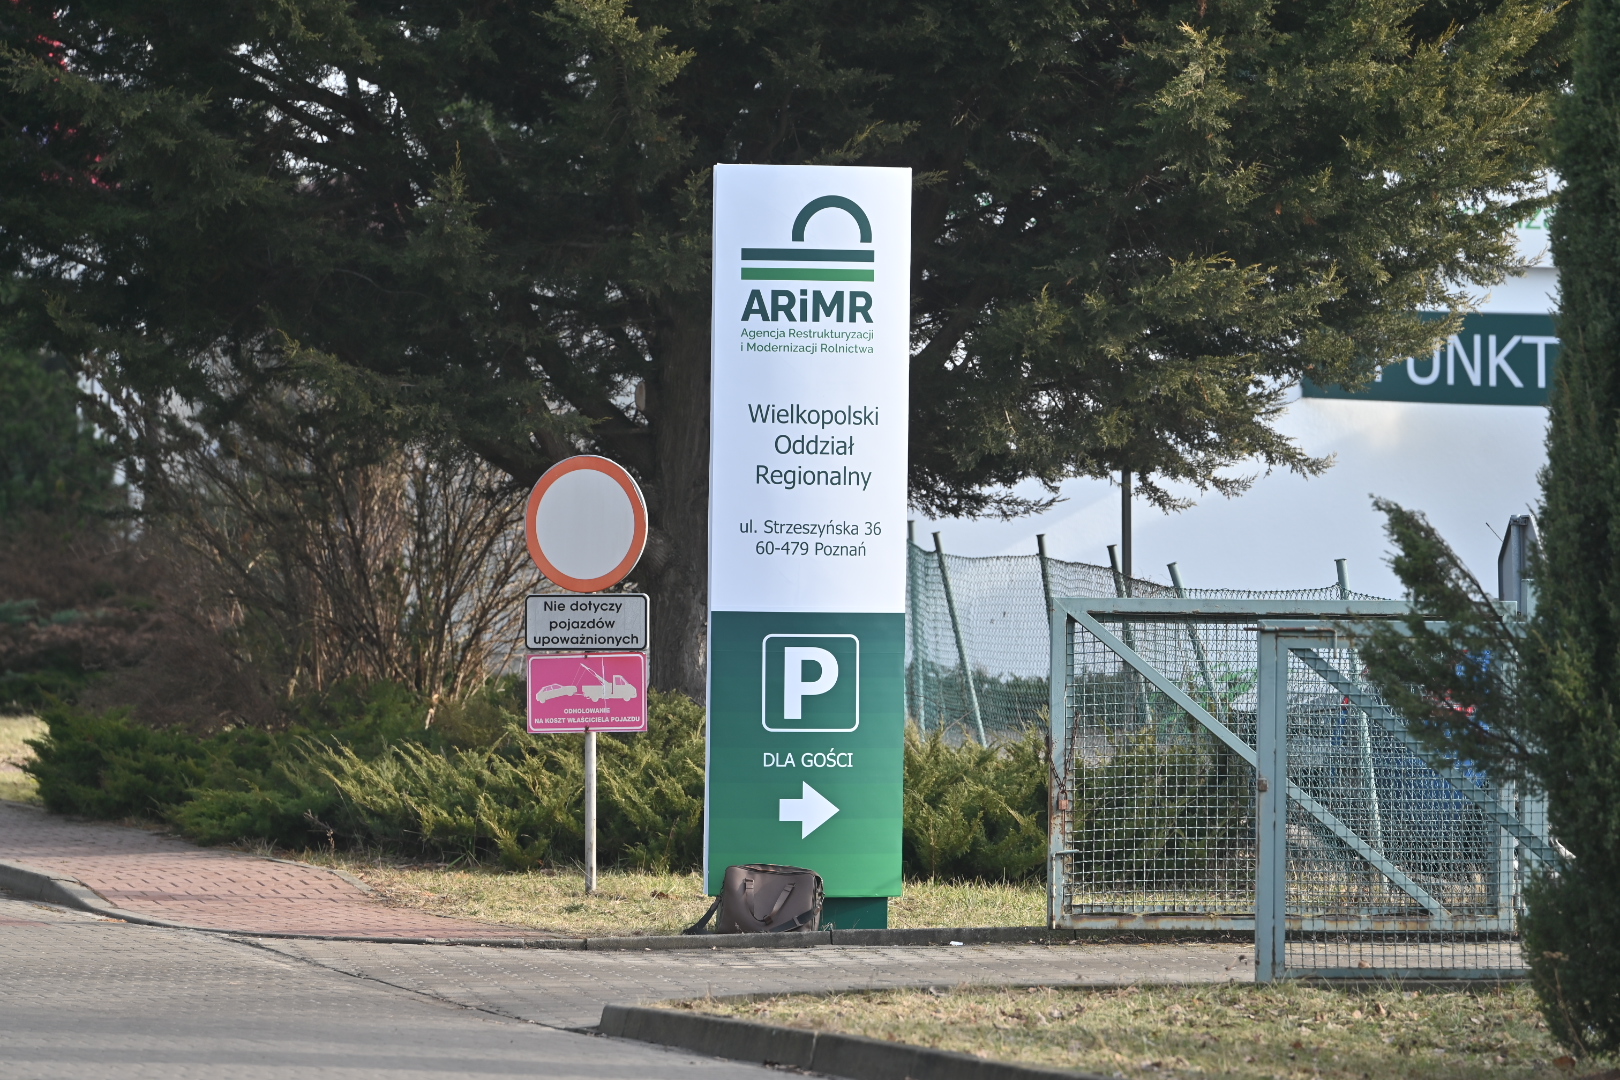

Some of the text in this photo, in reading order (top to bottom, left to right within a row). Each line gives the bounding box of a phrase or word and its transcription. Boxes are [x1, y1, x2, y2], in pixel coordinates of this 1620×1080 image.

[741, 289, 874, 323] ARiMR
[740, 328, 874, 342] Agencja Restrukturyzacji
[740, 342, 874, 354] i Modernizacji Rolnictwa
[1375, 333, 1560, 389] UNKT
[748, 403, 879, 429] Wielkopolski
[774, 434, 855, 456] Oddział
[756, 464, 872, 491] Regionalny
[739, 519, 882, 538] ul. Strzeszyńska 36
[755, 540, 866, 557] 60-479 Poznań
[543, 600, 623, 613] Nie dotyczy
[549, 617, 616, 632] pojazdów
[533, 633, 639, 647] upoważnionych
[783, 646, 839, 720] P
[567, 715, 610, 723] WŁAŚCICIELA
[763, 747, 853, 768] DLA GOŚCI
